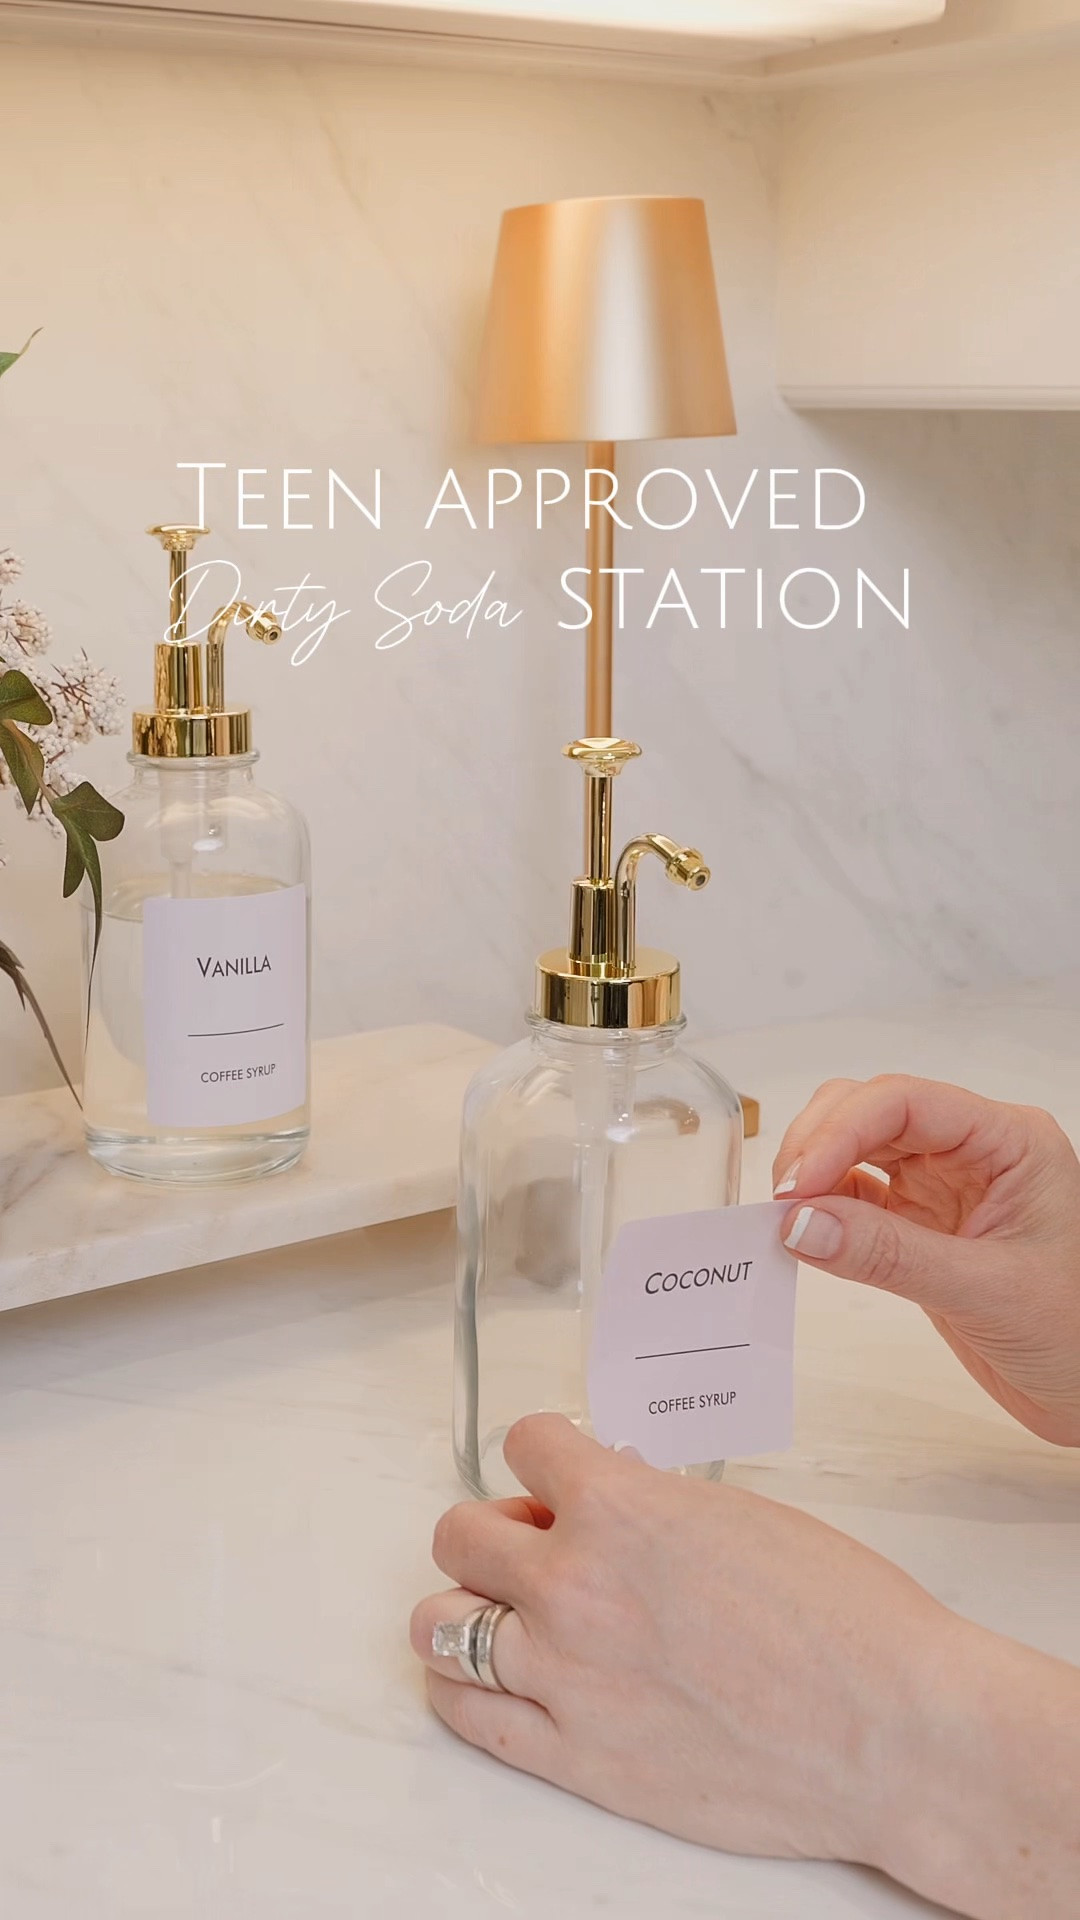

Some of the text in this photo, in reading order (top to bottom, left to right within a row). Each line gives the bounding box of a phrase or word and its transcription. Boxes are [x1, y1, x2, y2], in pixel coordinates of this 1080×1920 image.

[196, 954, 272, 979] VANILLA
[200, 1063, 276, 1084] COFFEE SYRUP
[644, 1260, 753, 1296] COCONUT
[648, 1391, 737, 1416] COFFEE SYRUP
